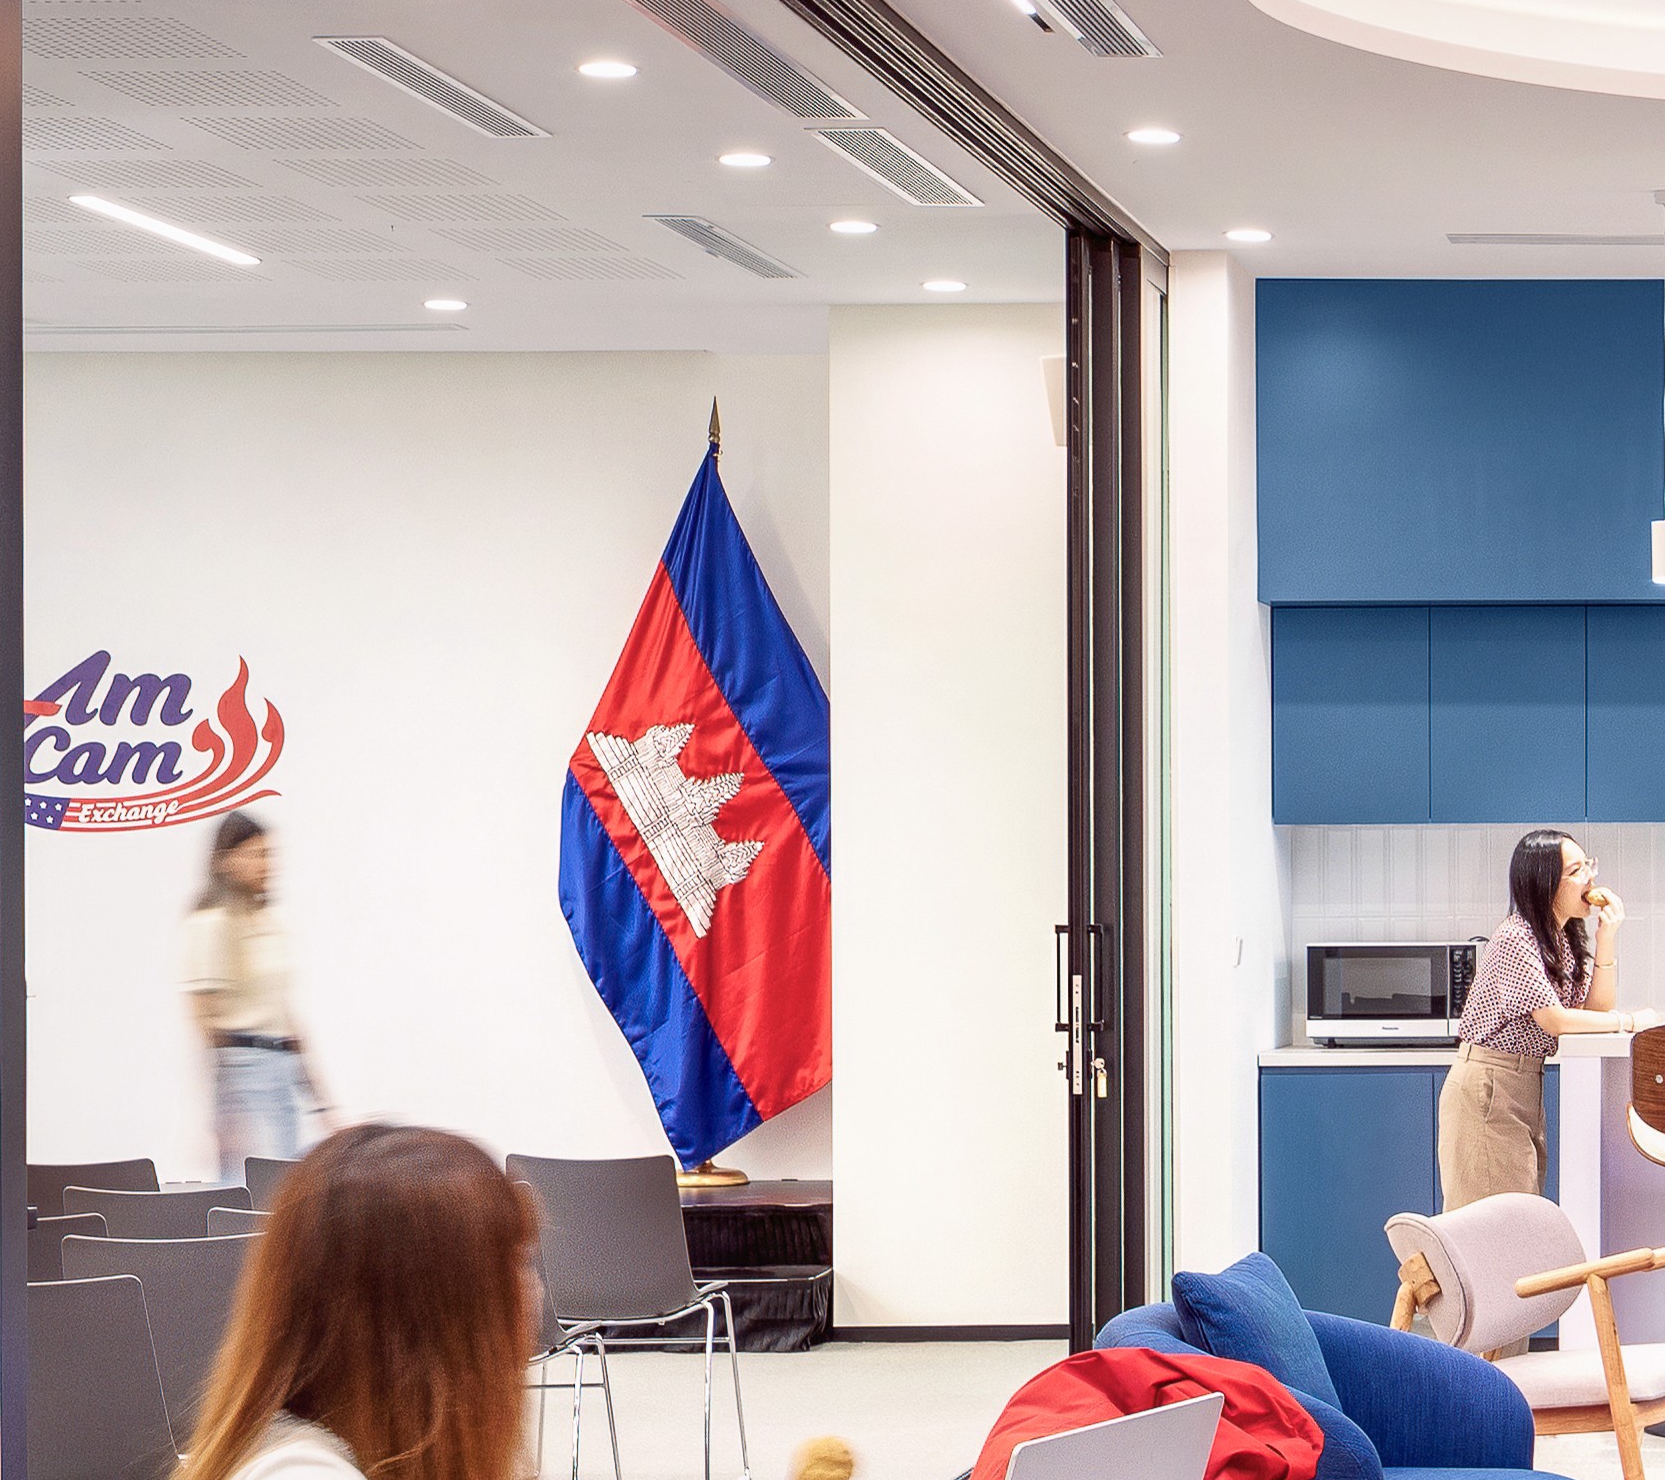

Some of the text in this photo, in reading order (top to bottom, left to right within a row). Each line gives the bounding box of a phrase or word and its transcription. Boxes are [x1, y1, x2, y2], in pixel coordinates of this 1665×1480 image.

[24, 649, 194, 727] Am
[24, 725, 184, 785] Cam
[78, 799, 180, 824] Exchange
